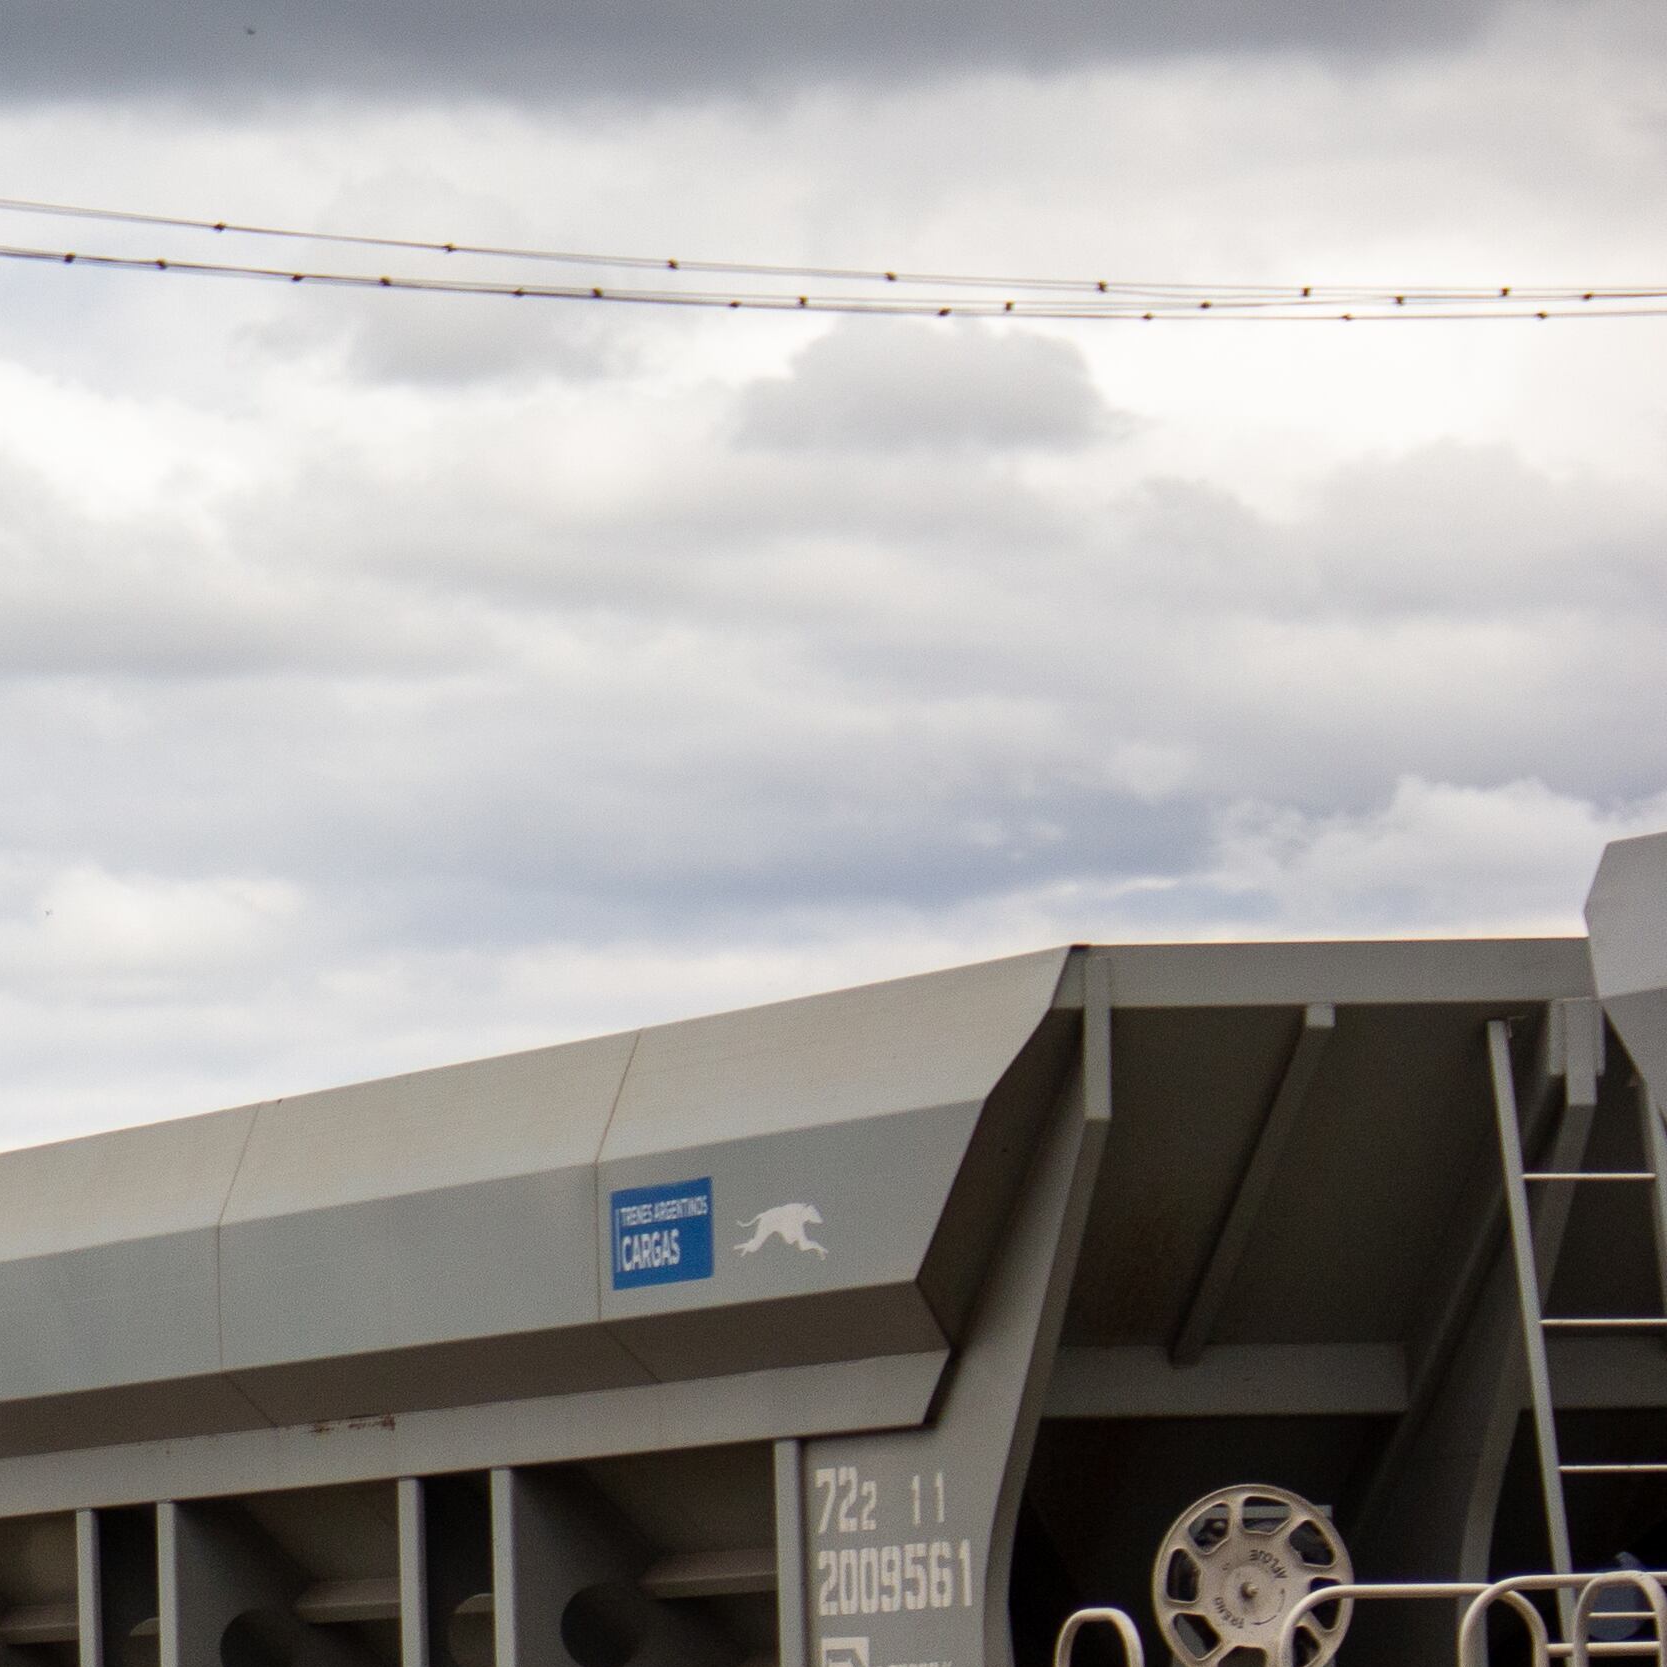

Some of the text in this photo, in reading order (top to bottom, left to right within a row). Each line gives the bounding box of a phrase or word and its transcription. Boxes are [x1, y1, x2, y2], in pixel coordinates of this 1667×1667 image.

[620, 1195, 709, 1226] TRENES ARGENTINOS
[622, 1228, 681, 1272] CARGAS
[814, 1467, 946, 1535] 722 11
[817, 1539, 974, 1617] 2009561
